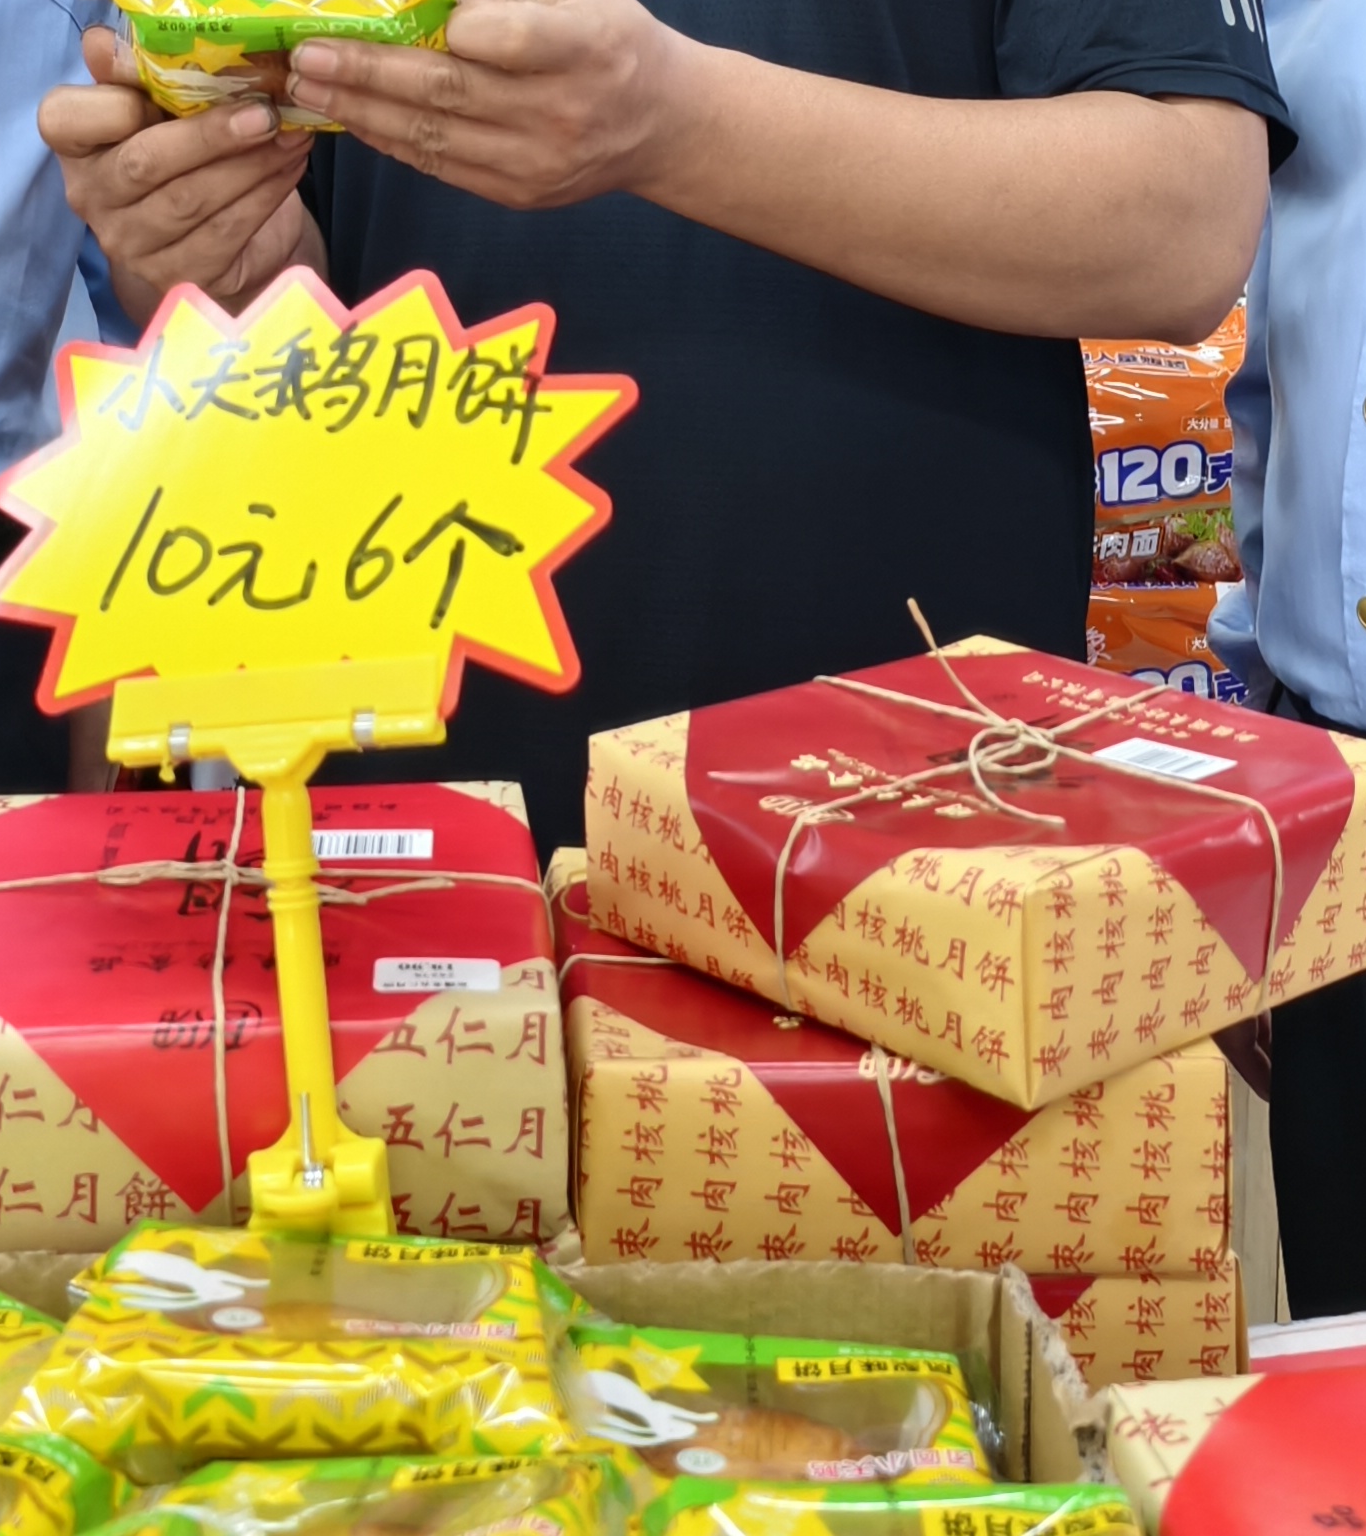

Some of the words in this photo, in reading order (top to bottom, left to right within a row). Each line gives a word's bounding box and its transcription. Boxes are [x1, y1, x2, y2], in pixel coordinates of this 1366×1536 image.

[98, 322, 552, 465] 小天鹅月饼
[1099, 444, 1232, 504] 120克
[1093, 527, 1160, 560] 肉面
